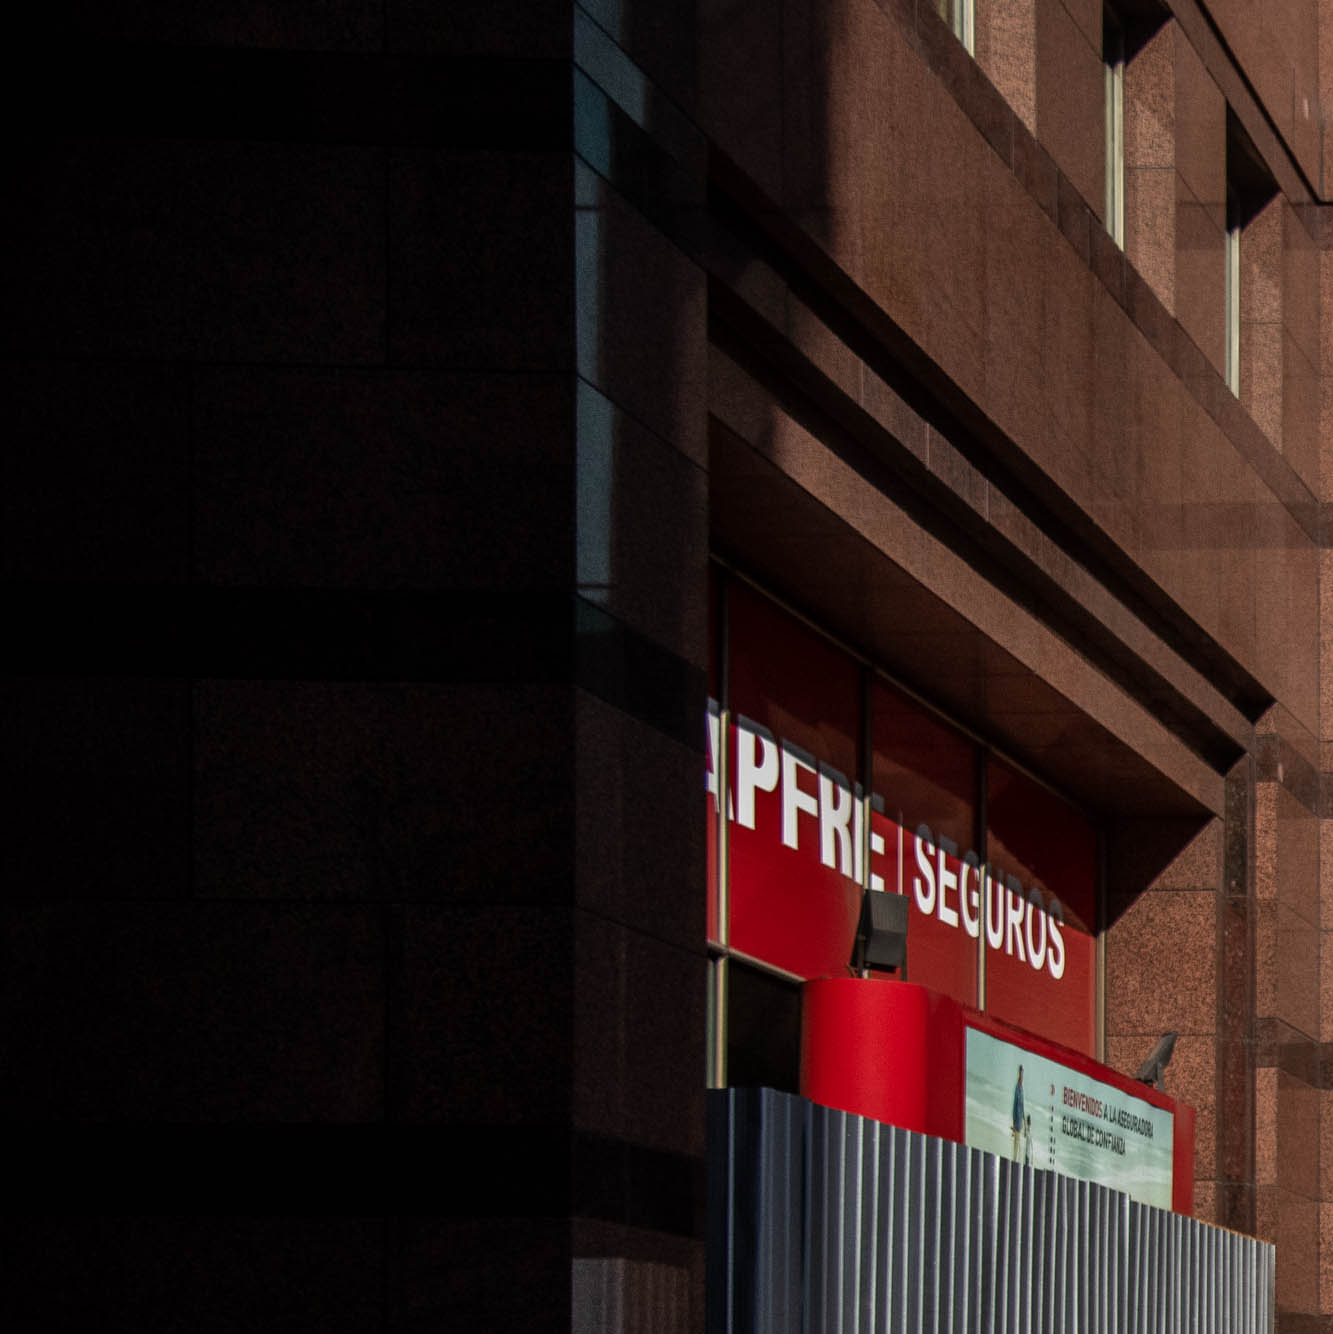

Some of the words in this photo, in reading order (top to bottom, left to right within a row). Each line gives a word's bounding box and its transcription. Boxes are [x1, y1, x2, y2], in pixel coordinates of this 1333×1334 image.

[912, 823, 1066, 980] SEGUROS
[1062, 1115, 1086, 1142] GLOBAL
[1087, 1123, 1096, 1145] DE
[1096, 1127, 1126, 1155] CONFIANZA
[1063, 1086, 1103, 1119] BIENVENIDOS
[1109, 1105, 1118, 1125] LA
[1118, 1107, 1154, 1138] ASEGURADORA
